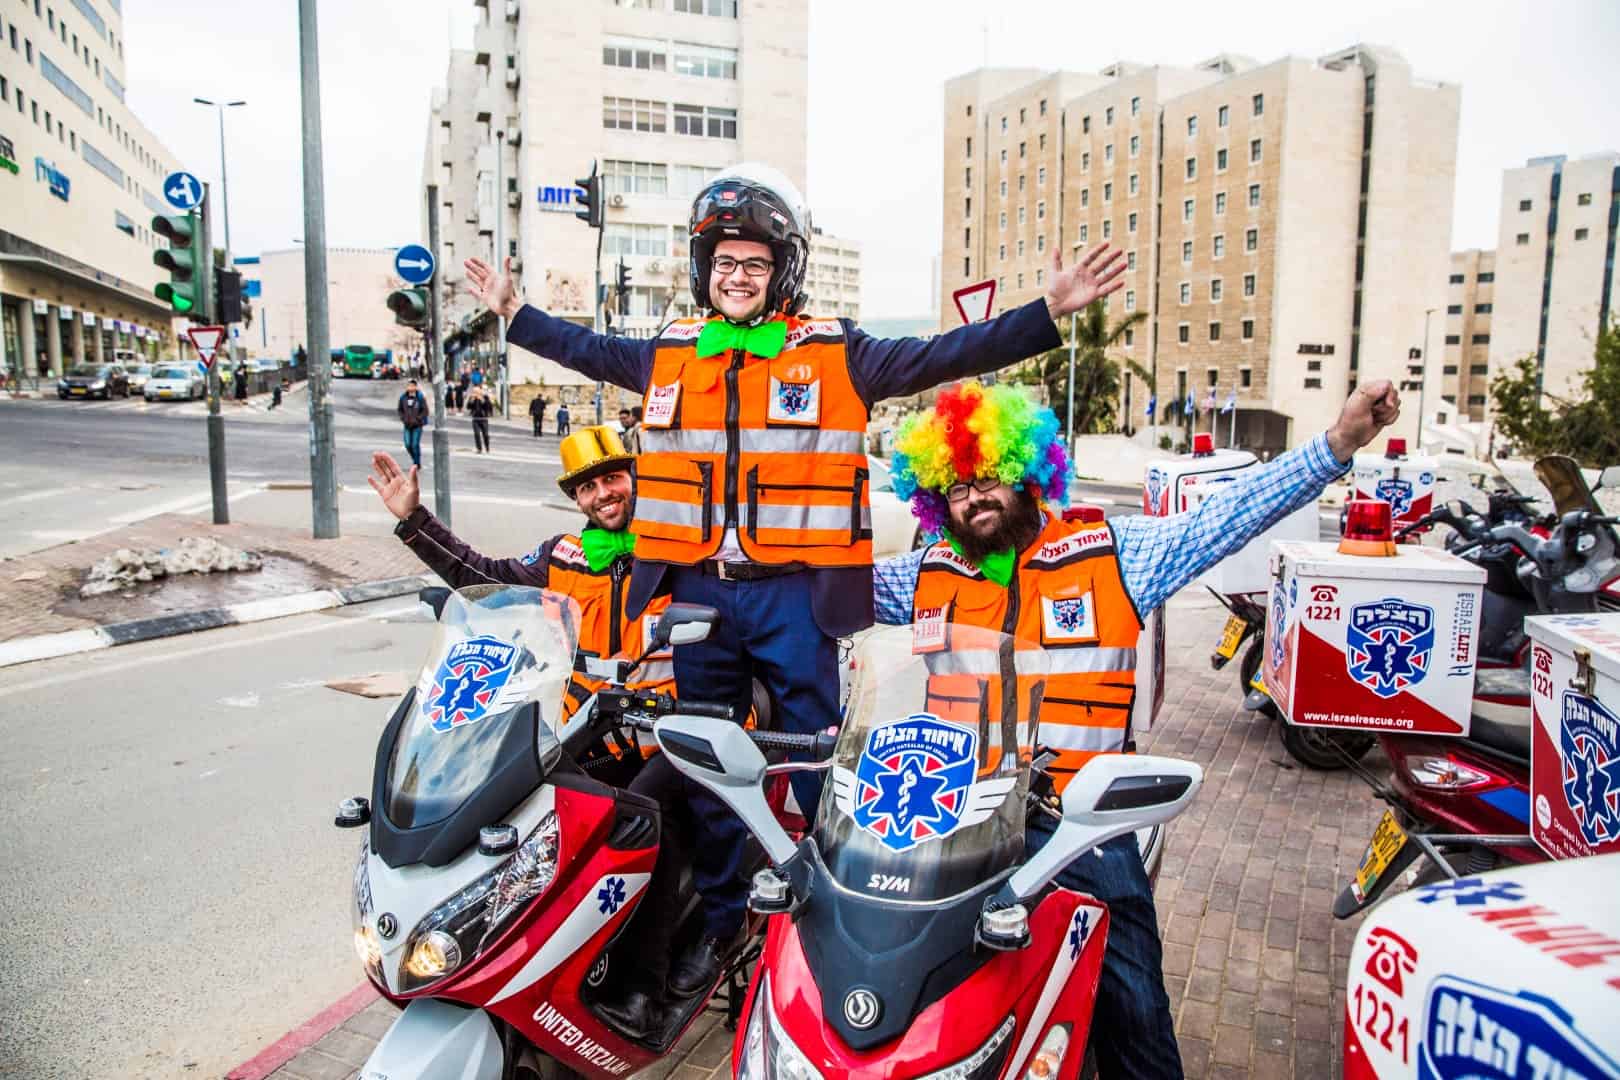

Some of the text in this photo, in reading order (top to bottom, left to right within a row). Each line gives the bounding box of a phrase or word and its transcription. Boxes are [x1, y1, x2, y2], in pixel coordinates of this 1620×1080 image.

[1041, 532, 1109, 558] איחוד הצלה
[917, 608, 942, 619] חובש
[1305, 606, 1341, 621] 1221
[1356, 609, 1426, 629] הצלה
[1533, 672, 1552, 700] 1221
[1304, 712, 1414, 729] www.israelrescue.org
[1566, 696, 1590, 723] הצלה
[873, 726, 967, 757] איחוד הצלה
[1591, 710, 1617, 751] איחוד
[866, 873, 911, 893] SYM
[1354, 983, 1408, 1064] 1221
[1434, 991, 1521, 1077] הצלה
[533, 1001, 632, 1076] UNITED HATZALAH
